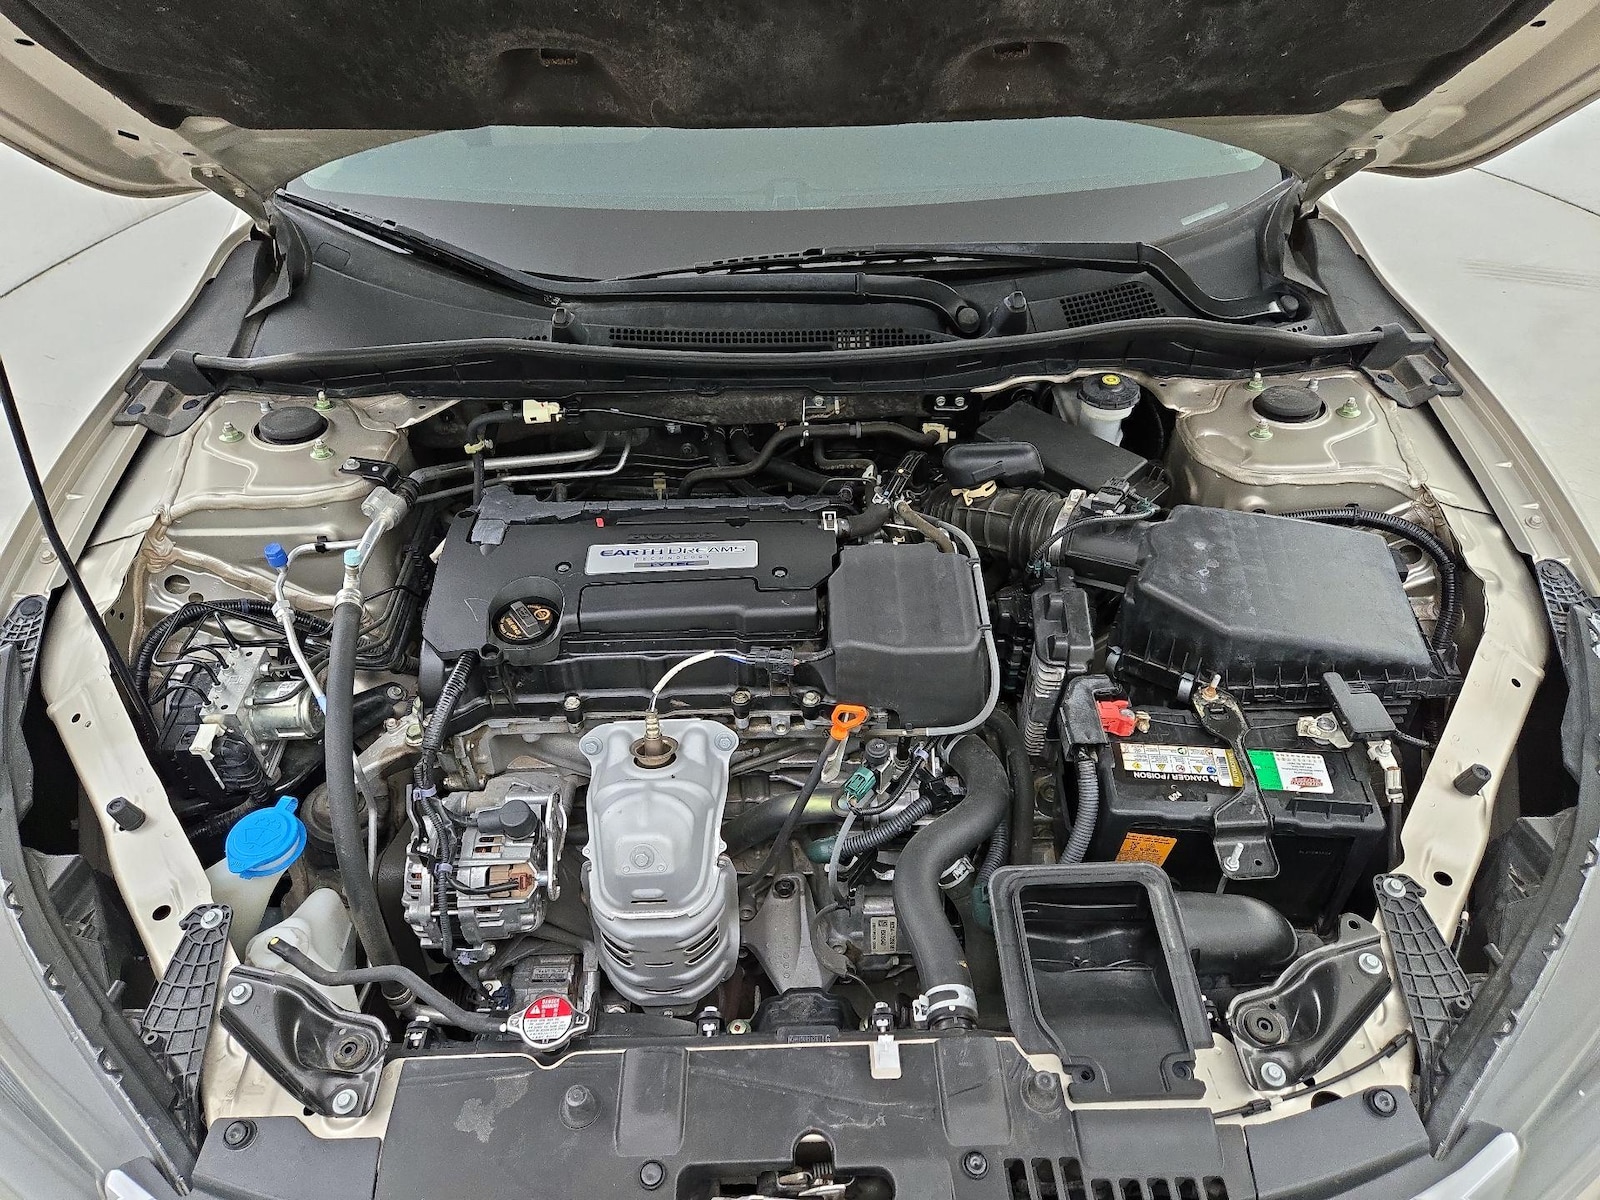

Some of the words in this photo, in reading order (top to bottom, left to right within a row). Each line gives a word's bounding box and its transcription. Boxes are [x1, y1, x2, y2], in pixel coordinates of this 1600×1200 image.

[600, 548, 663, 557] EARTH
[668, 545, 746, 555] DREAMS
[1133, 771, 1165, 780] POISON
[1172, 774, 1210, 782] DANGER
